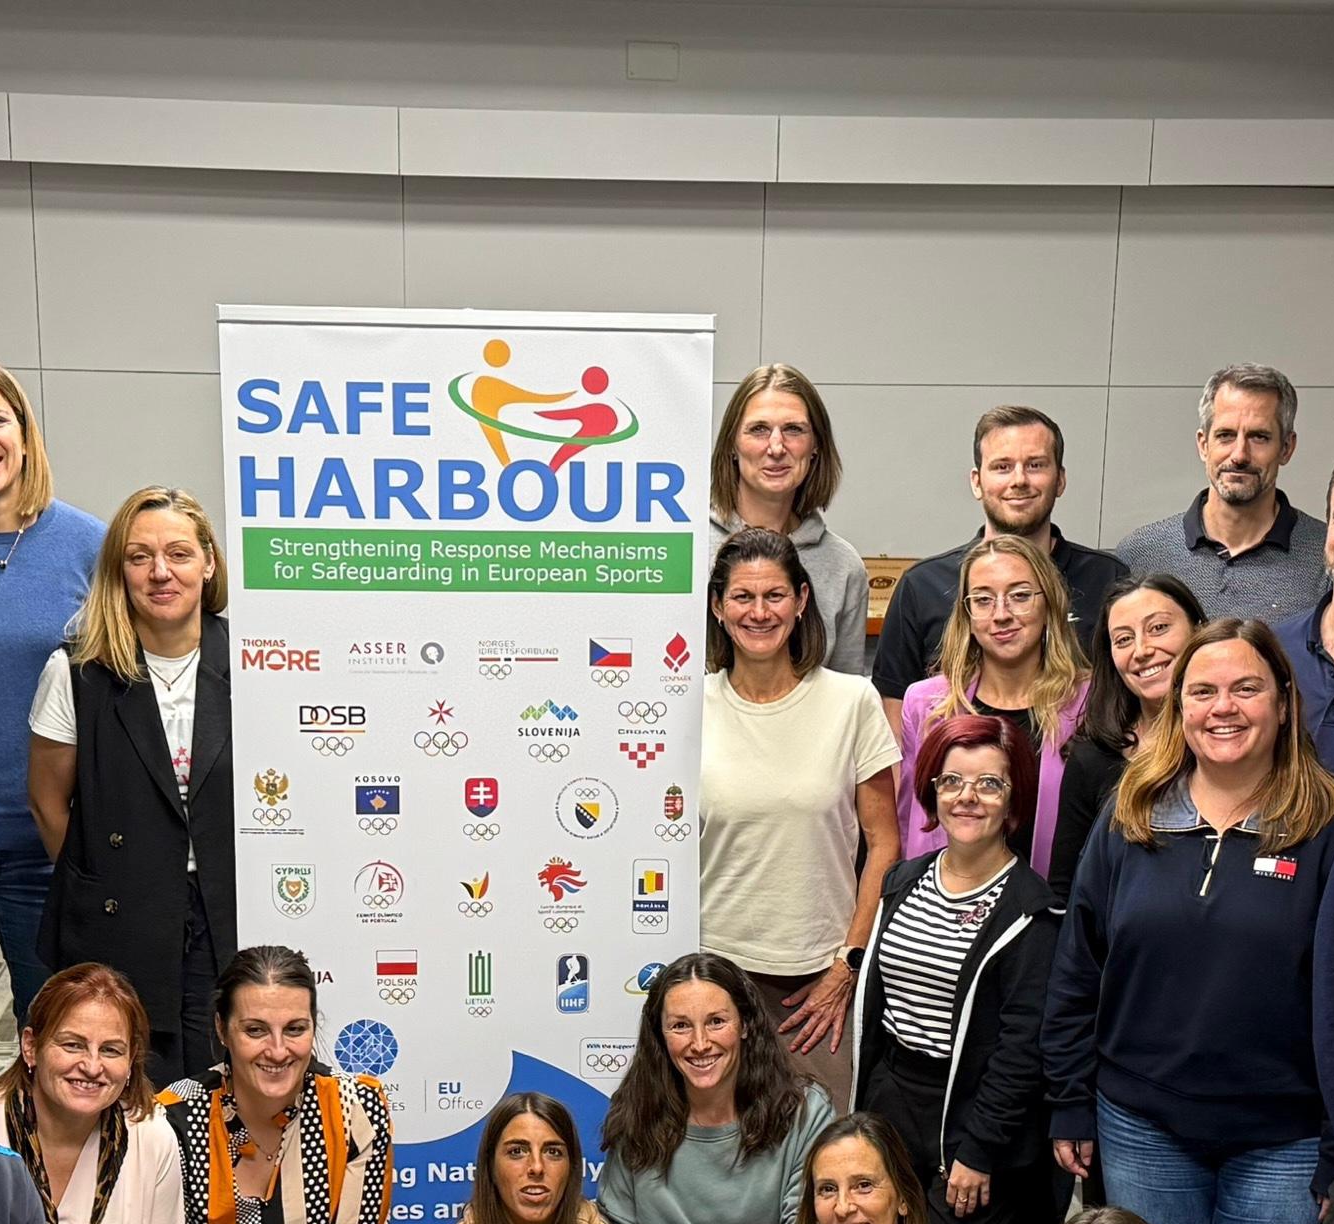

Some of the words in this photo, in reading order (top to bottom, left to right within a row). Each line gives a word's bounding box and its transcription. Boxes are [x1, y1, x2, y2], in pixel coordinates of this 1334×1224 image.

[237, 379, 431, 436] SAFE
[240, 456, 691, 523] HARBOUR
[269, 539, 421, 560] Strengthening
[431, 540, 531, 563] Response
[540, 541, 667, 560] Mechanisms
[274, 562, 304, 579] for
[312, 563, 452, 585] Safeguarding
[461, 564, 479, 581] in
[488, 564, 587, 585] European
[595, 564, 663, 585] Sports
[241, 639, 286, 648] THOMAS
[349, 642, 406, 654] ASSER
[478, 640, 516, 648] NORGES
[242, 649, 320, 671] MORE
[348, 657, 406, 665] INSTITUTE
[299, 705, 366, 725] DOSB
[518, 727, 580, 738] SLOVENIJA
[355, 775, 401, 783] KOSOVO
[275, 867, 311, 876] CYPRUS
[377, 978, 417, 987] POLSKA
[561, 998, 585, 1007] IIHF
[438, 1082, 461, 1094] EU
[438, 1097, 483, 1110] Office
[428, 1163, 477, 1182] Nat
